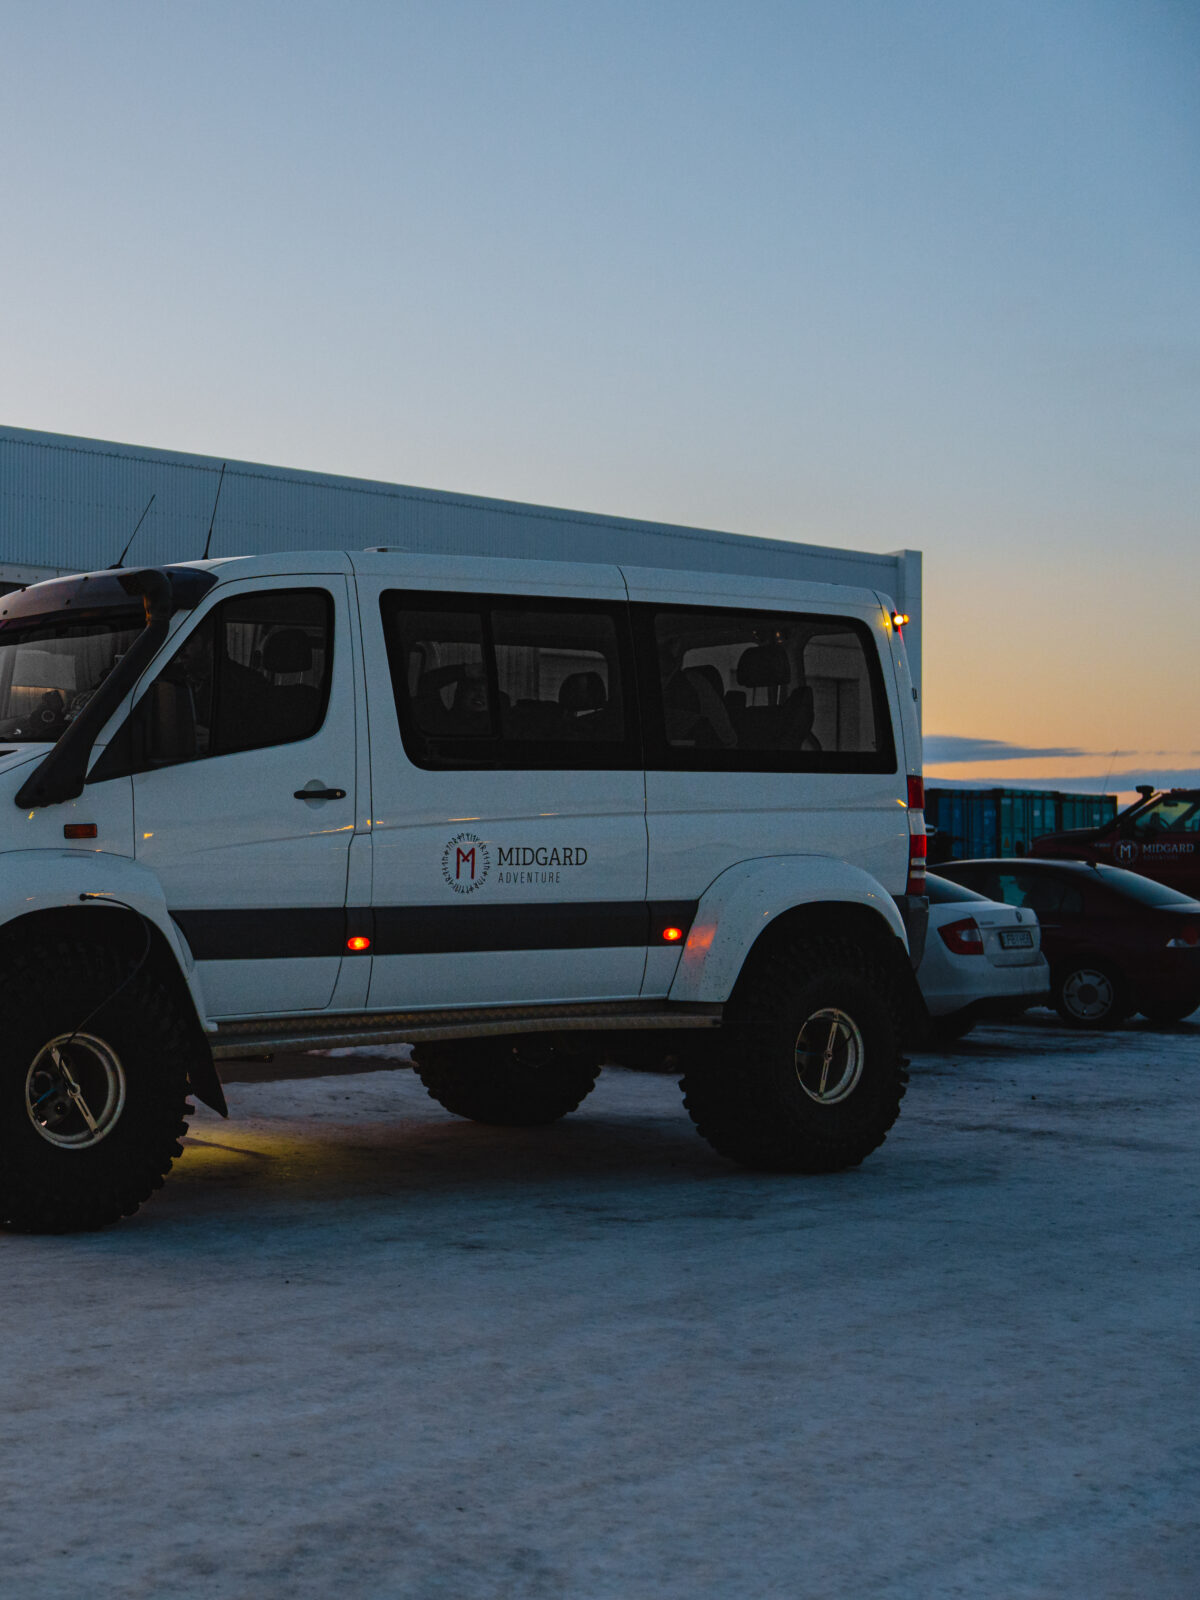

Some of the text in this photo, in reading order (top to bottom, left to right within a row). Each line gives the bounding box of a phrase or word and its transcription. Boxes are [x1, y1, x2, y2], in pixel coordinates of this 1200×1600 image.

[1142, 843, 1195, 854] MIDGARD
[497, 847, 588, 866] MIDGARD
[498, 871, 561, 884] ADVENTURE
